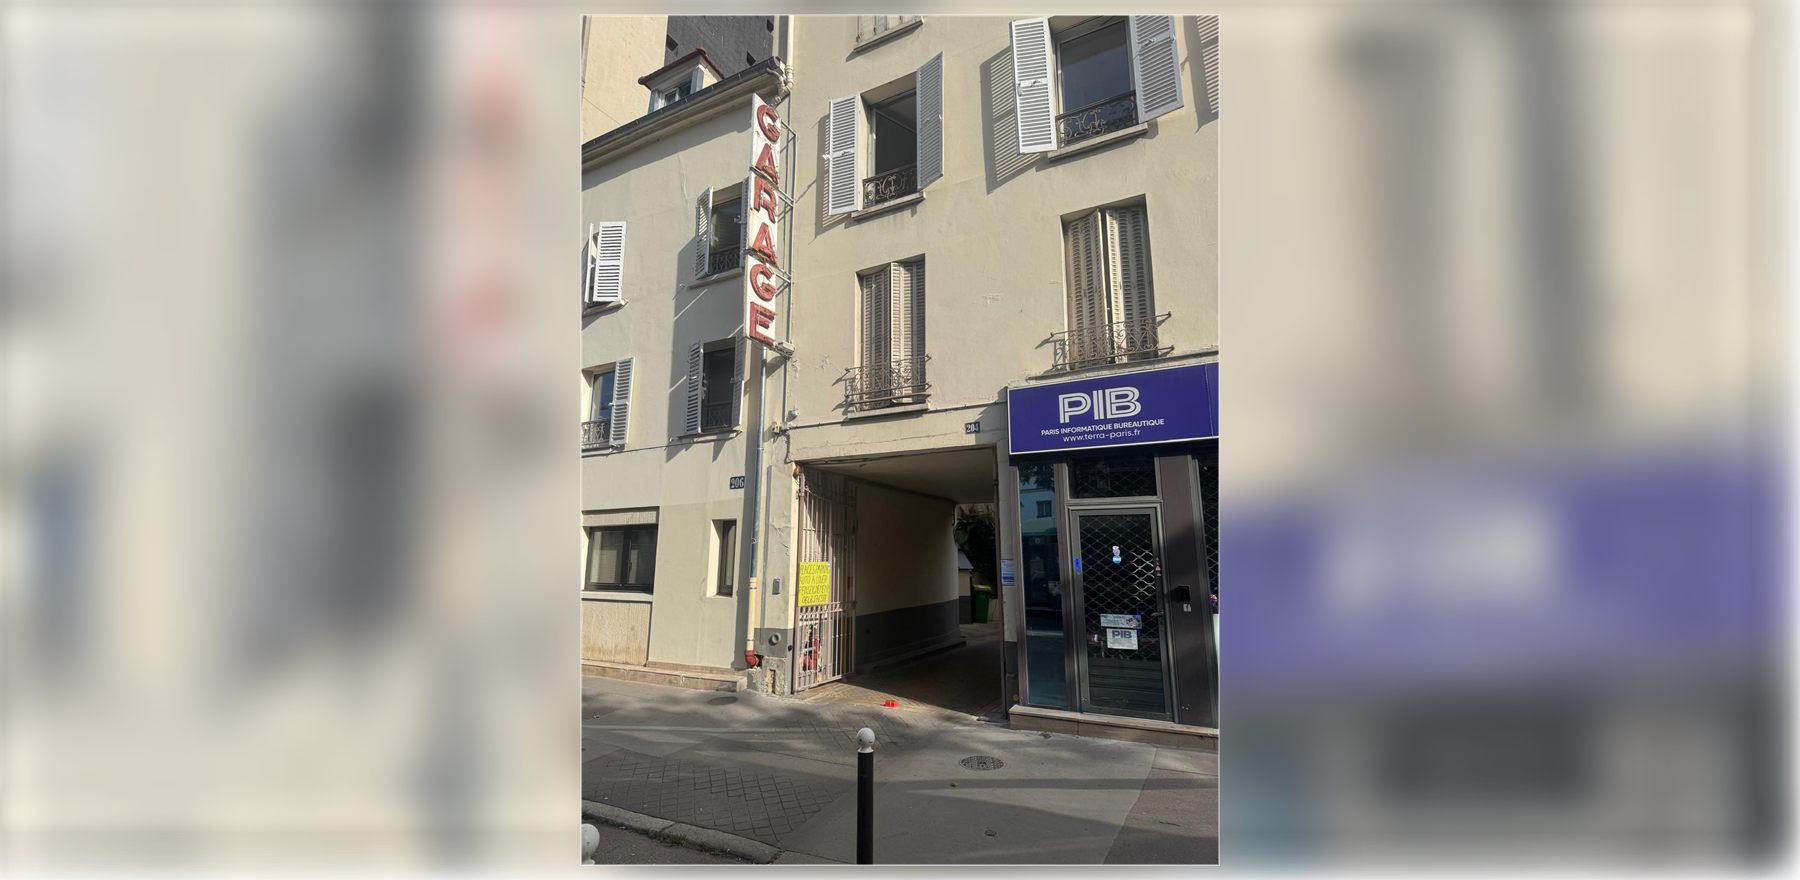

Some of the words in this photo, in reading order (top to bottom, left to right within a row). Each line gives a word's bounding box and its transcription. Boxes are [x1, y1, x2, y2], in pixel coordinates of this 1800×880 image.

[750, 104, 781, 346] GARAGE
[1058, 386, 1142, 424] PIB
[1041, 428, 1060, 436] PARIS
[1060, 423, 1113, 434] INFORMATIQUE
[1113, 418, 1165, 430] BUREAUTIQUE
[1063, 428, 1141, 442] www.terra-paris.fr
[730, 476, 744, 489] 206
[1112, 630, 1132, 639] PIB
